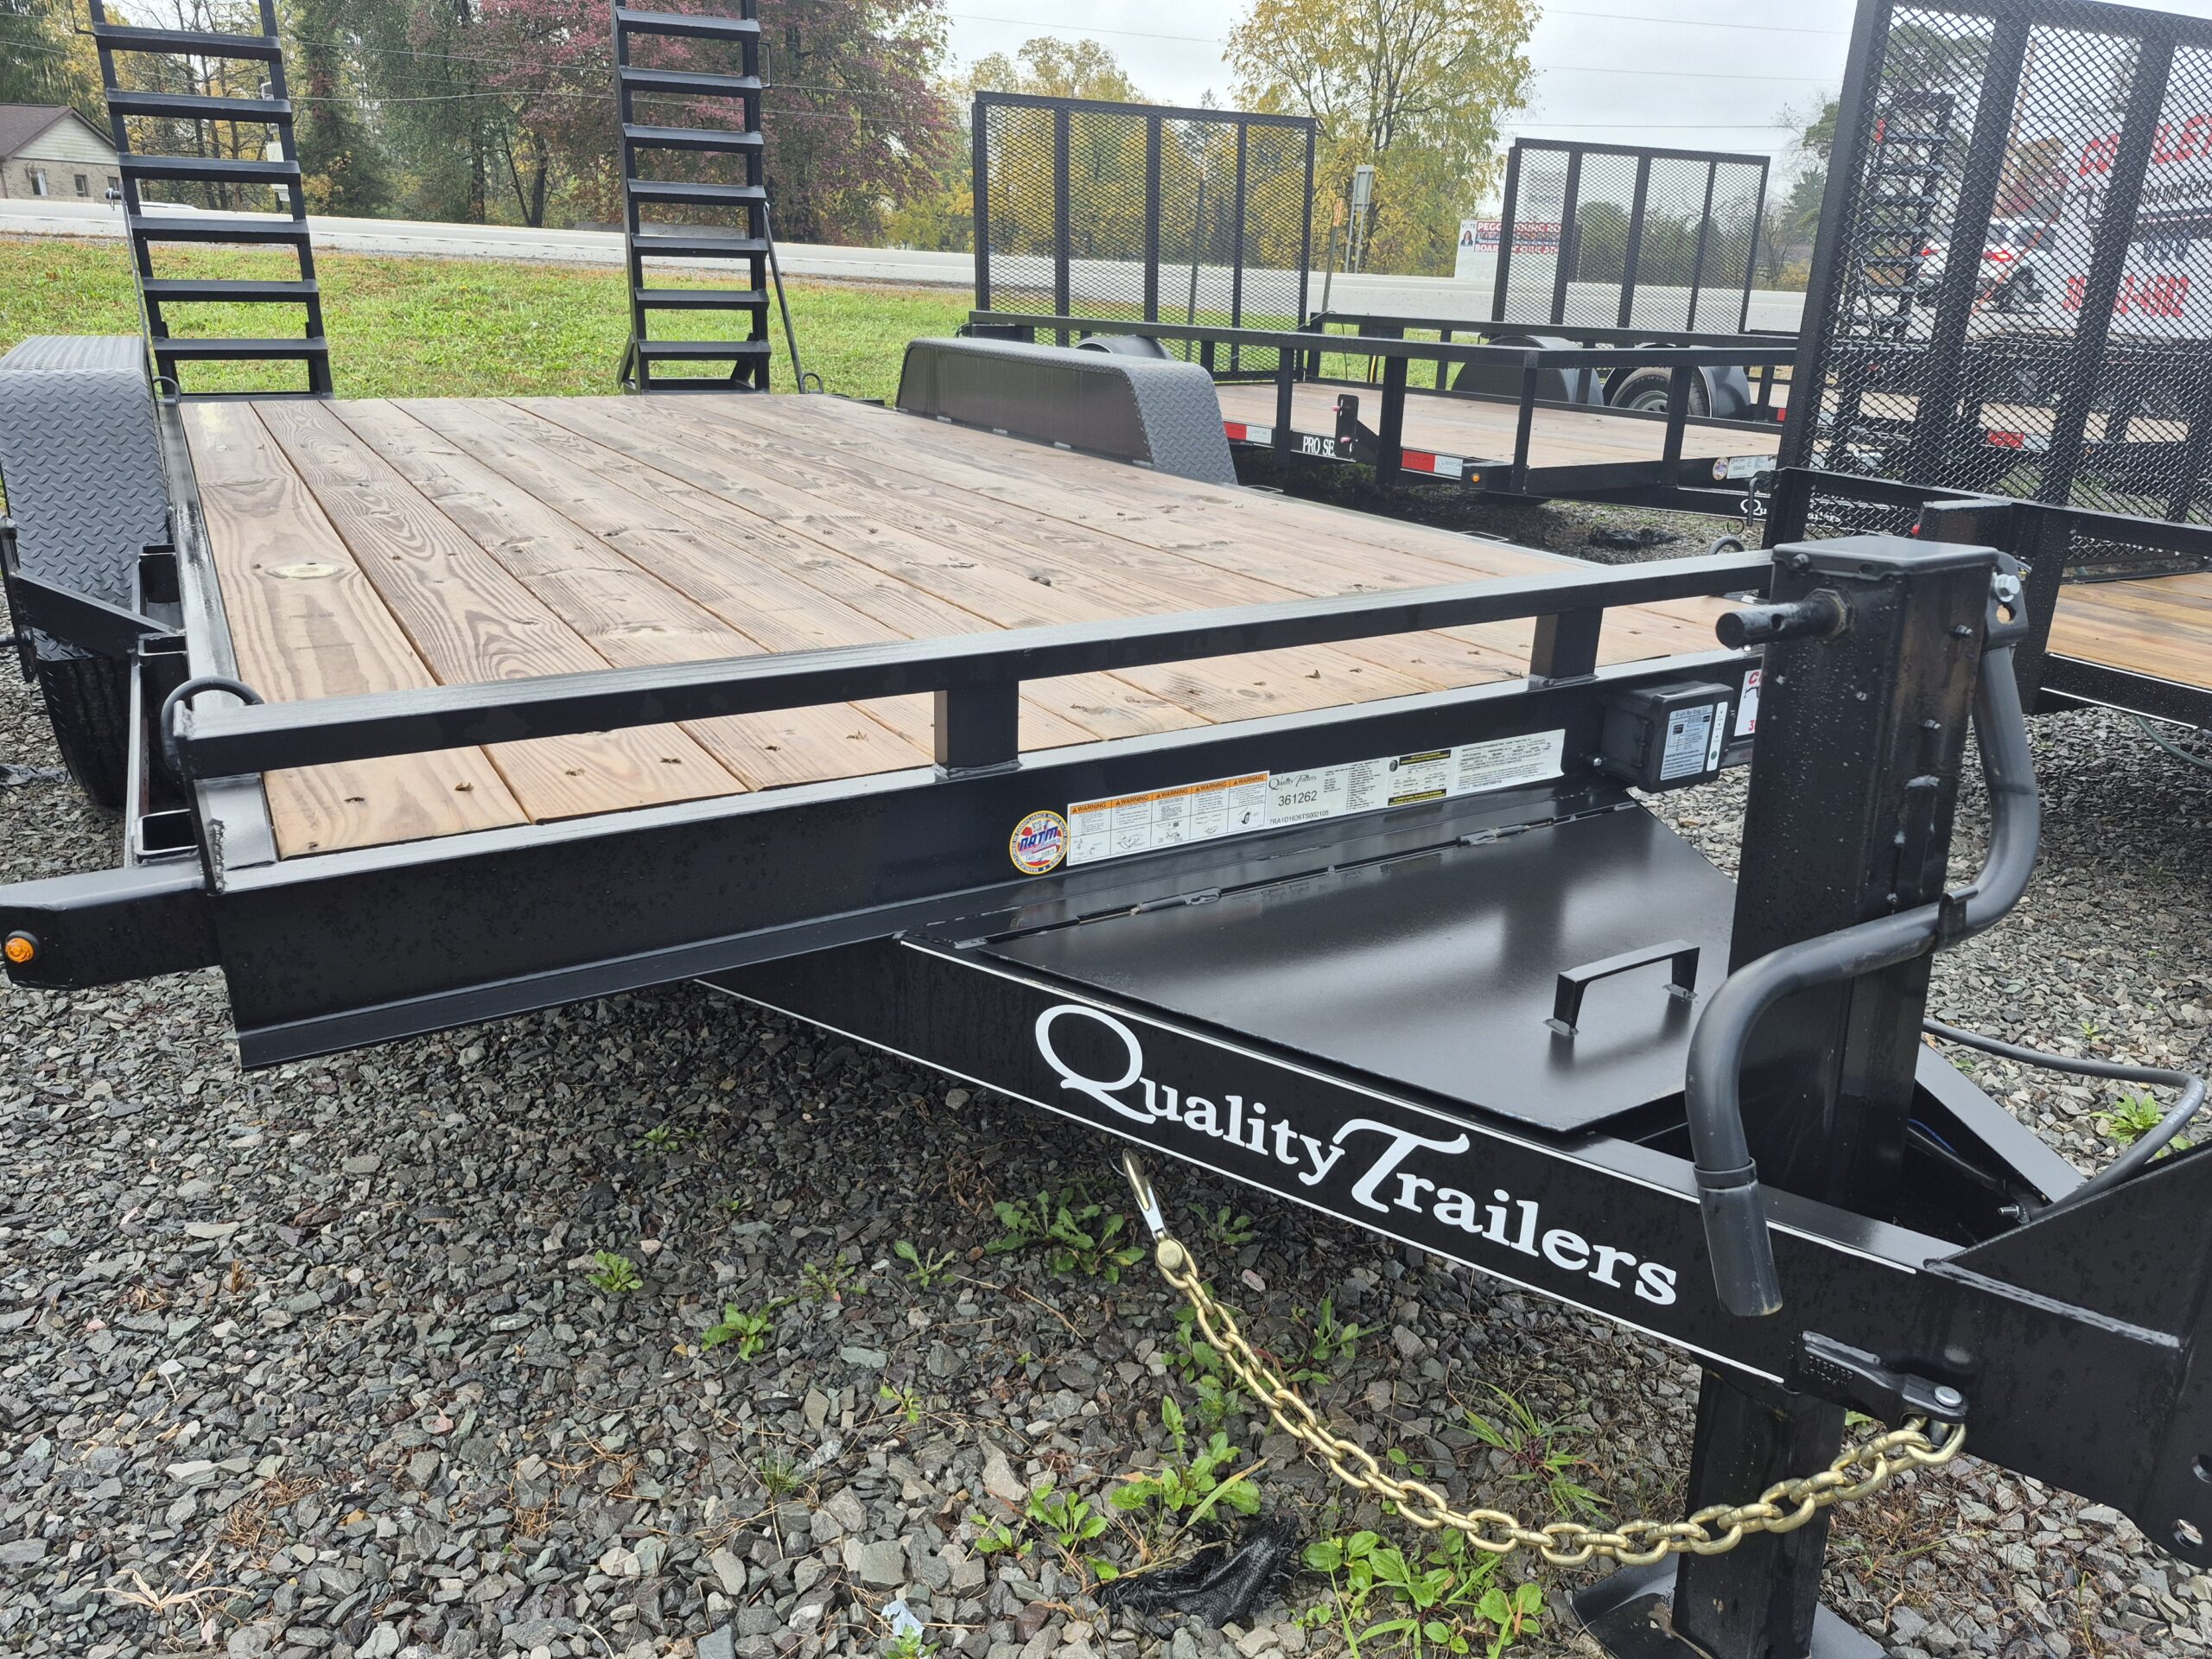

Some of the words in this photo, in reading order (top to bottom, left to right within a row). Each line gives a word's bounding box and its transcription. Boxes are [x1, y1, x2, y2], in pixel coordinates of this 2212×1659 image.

[1302, 435, 1320, 454] PRO
[1238, 775, 1264, 785] WARNING
[1268, 775, 1294, 791] Quality
[1294, 774, 1317, 787] Trailers
[1199, 781, 1227, 791] WARNING
[1160, 788, 1189, 798] WARNING
[1121, 795, 1149, 805] WARNING
[1278, 790, 1318, 807] 361262
[1077, 802, 1107, 812] WARNING
[1034, 1003, 1345, 1187] Quality
[1331, 1118, 1678, 1307] Trailers
